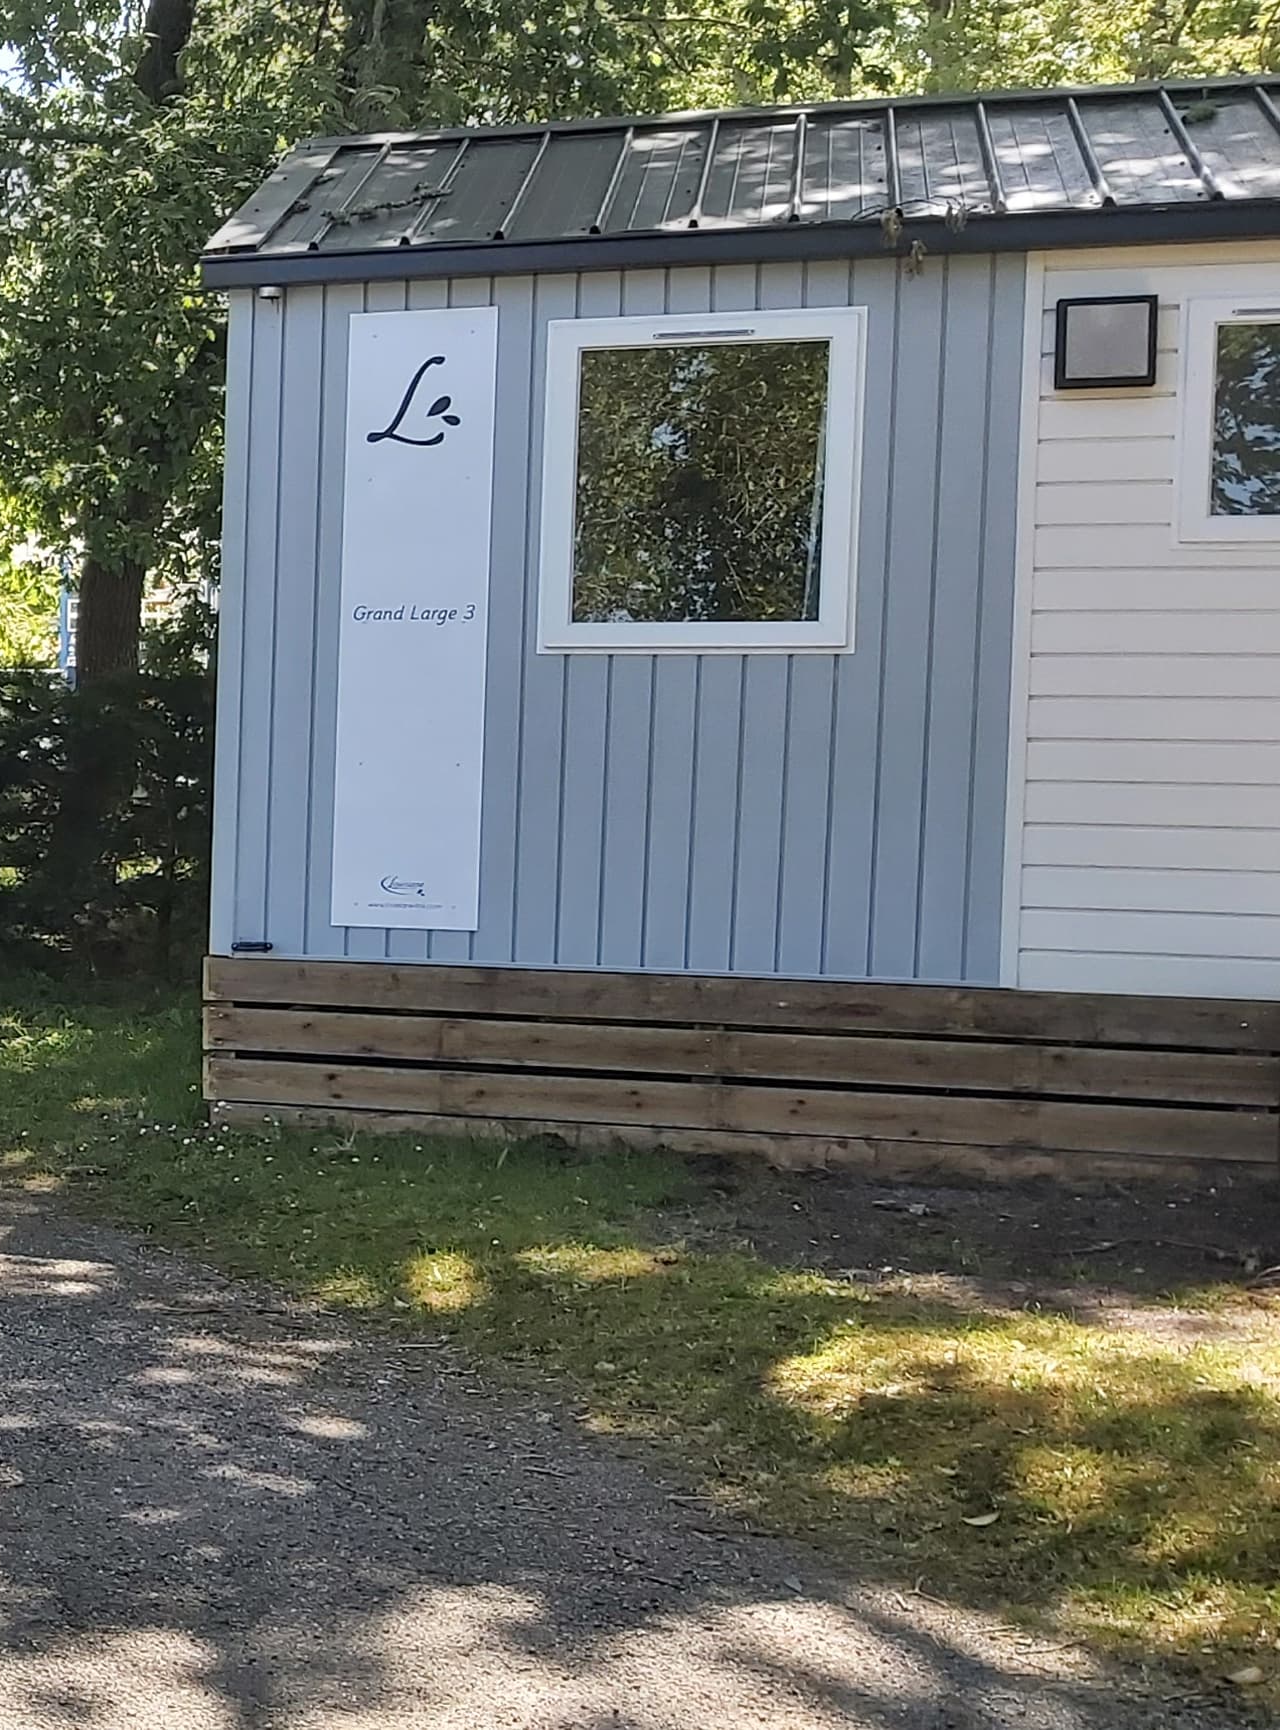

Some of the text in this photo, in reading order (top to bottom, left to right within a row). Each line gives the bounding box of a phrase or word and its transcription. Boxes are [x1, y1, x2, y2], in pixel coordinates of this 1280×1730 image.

[353, 604, 476, 626] Grand Large 3
